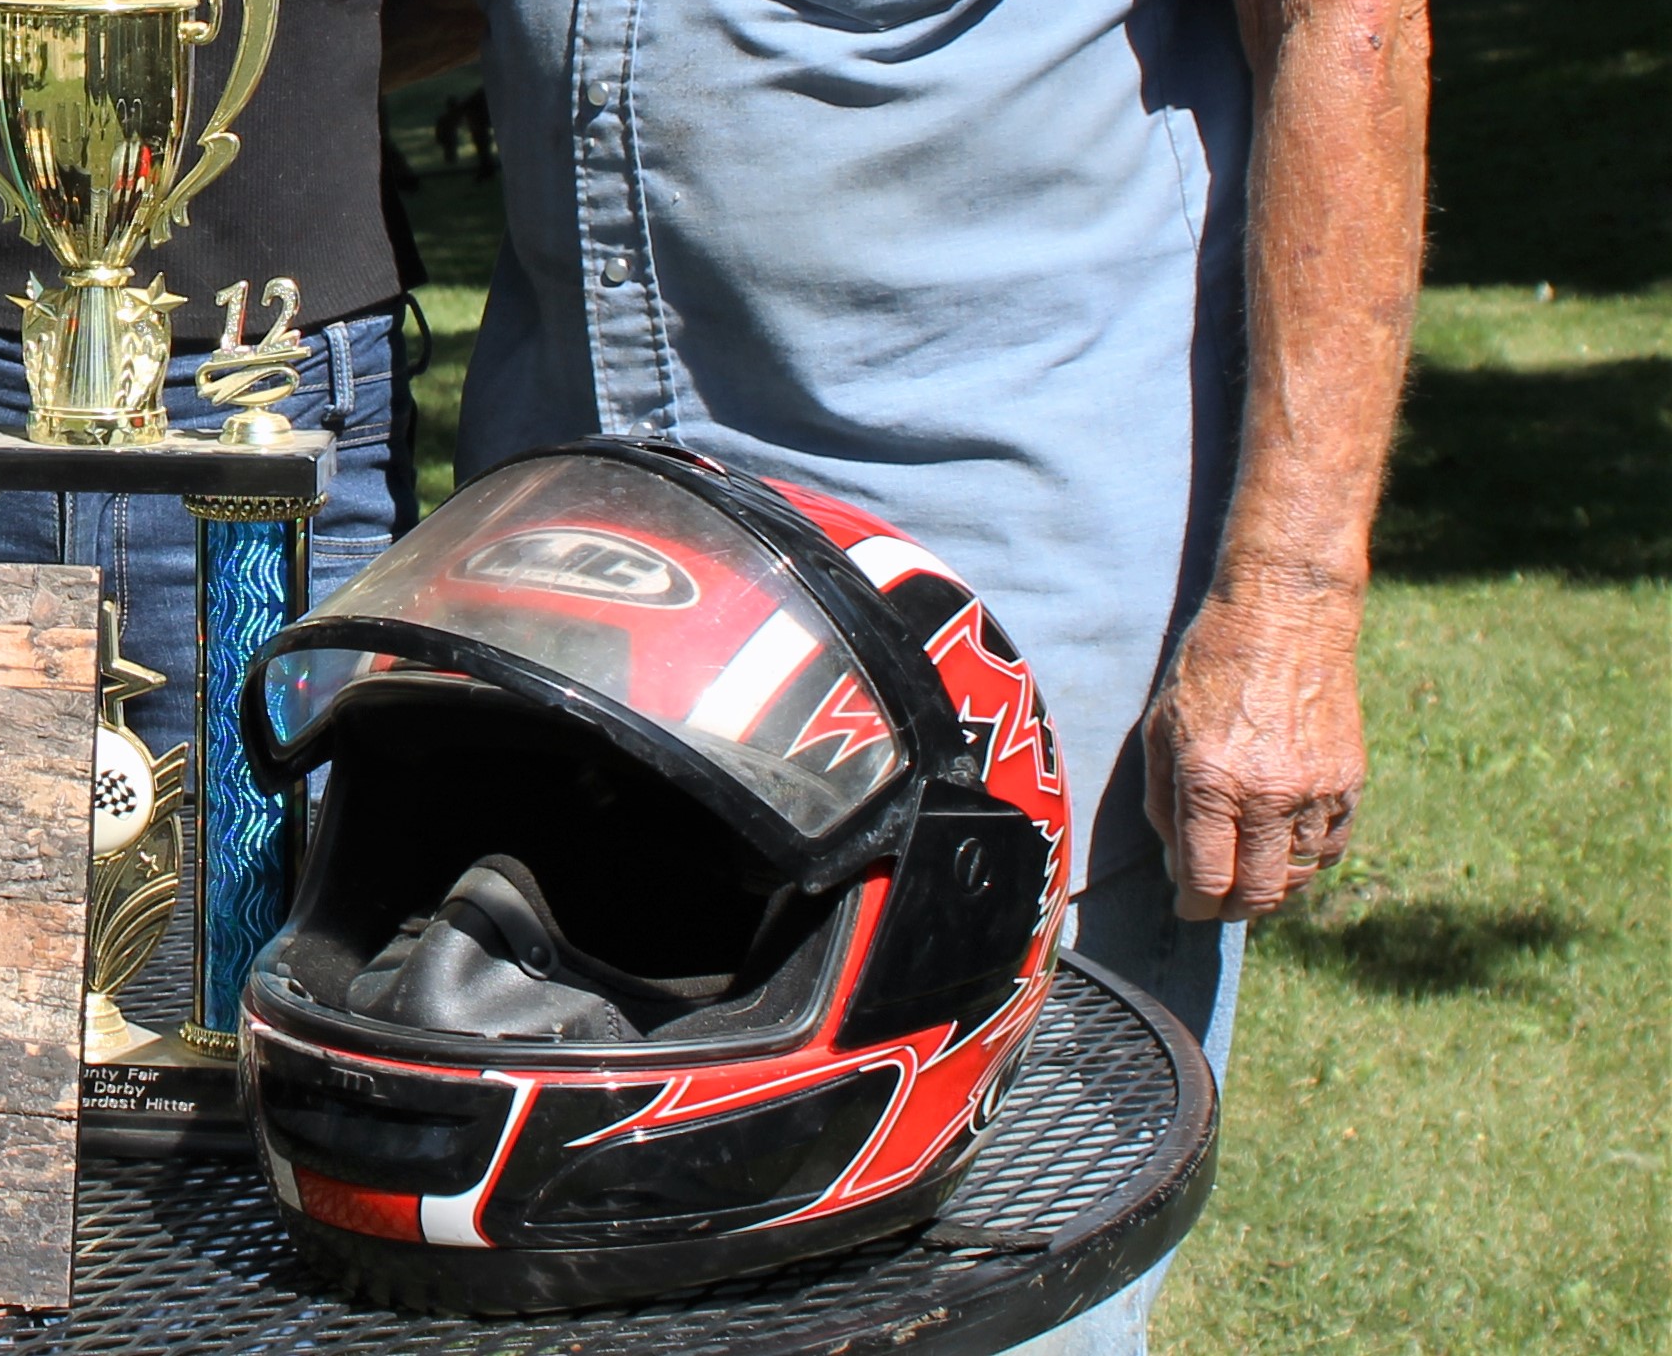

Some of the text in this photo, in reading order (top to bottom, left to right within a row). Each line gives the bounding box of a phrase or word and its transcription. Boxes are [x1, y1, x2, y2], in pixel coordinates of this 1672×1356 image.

[216, 276, 302, 354] 12
[128, 1068, 160, 1082] Fair
[82, 1095, 196, 1112] ardest Hitter
